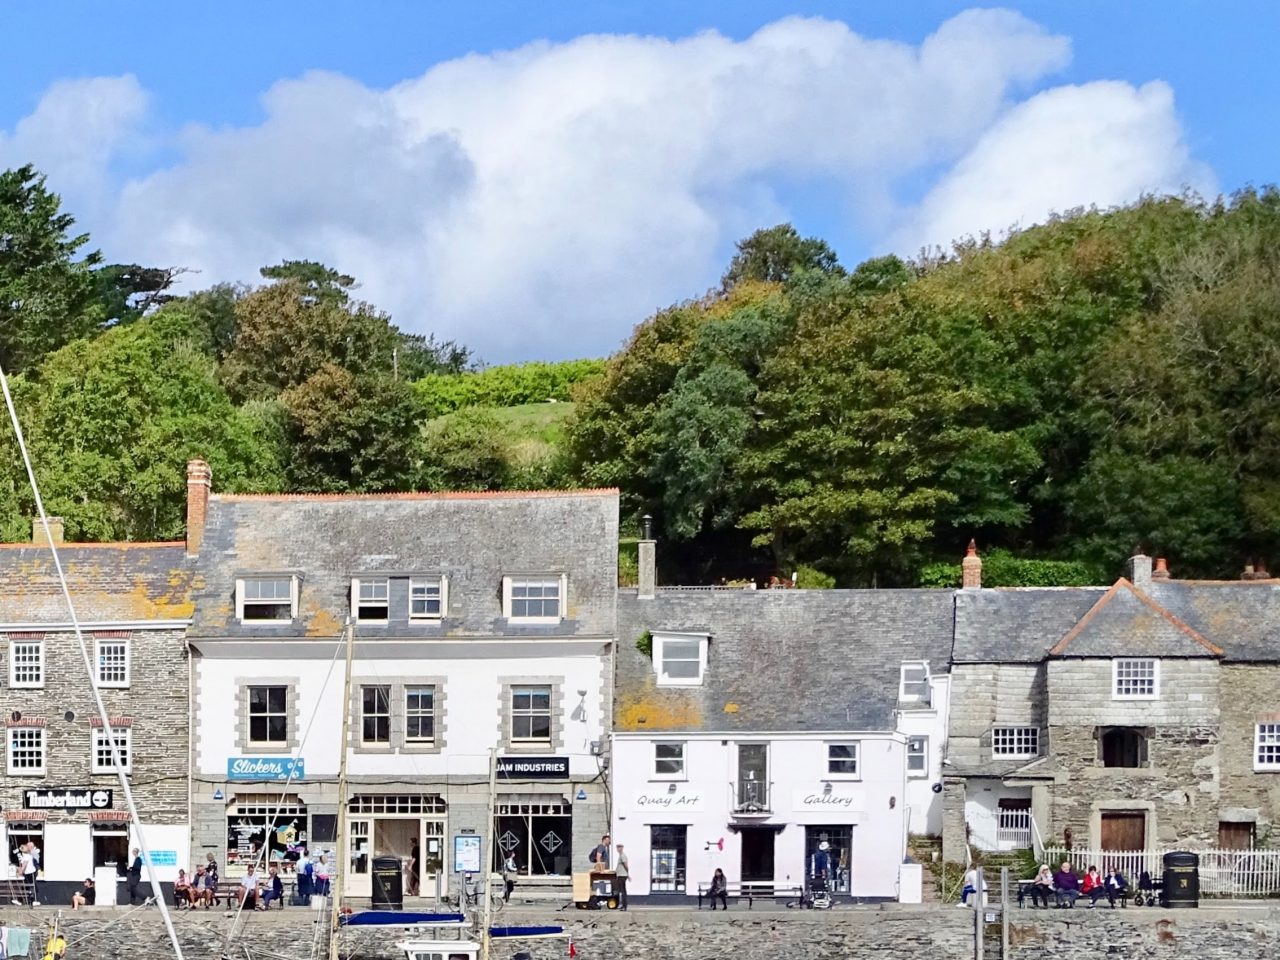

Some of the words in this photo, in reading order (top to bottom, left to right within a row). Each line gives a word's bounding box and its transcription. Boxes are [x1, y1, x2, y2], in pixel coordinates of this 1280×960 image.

[231, 759, 283, 774] Slickers
[496, 763, 513, 772] JAM
[514, 763, 566, 772] INDUSTRIES
[26, 791, 92, 807] Timberland
[637, 795, 671, 807] Quay
[676, 795, 700, 805] Art
[803, 794, 853, 807] Gallery
